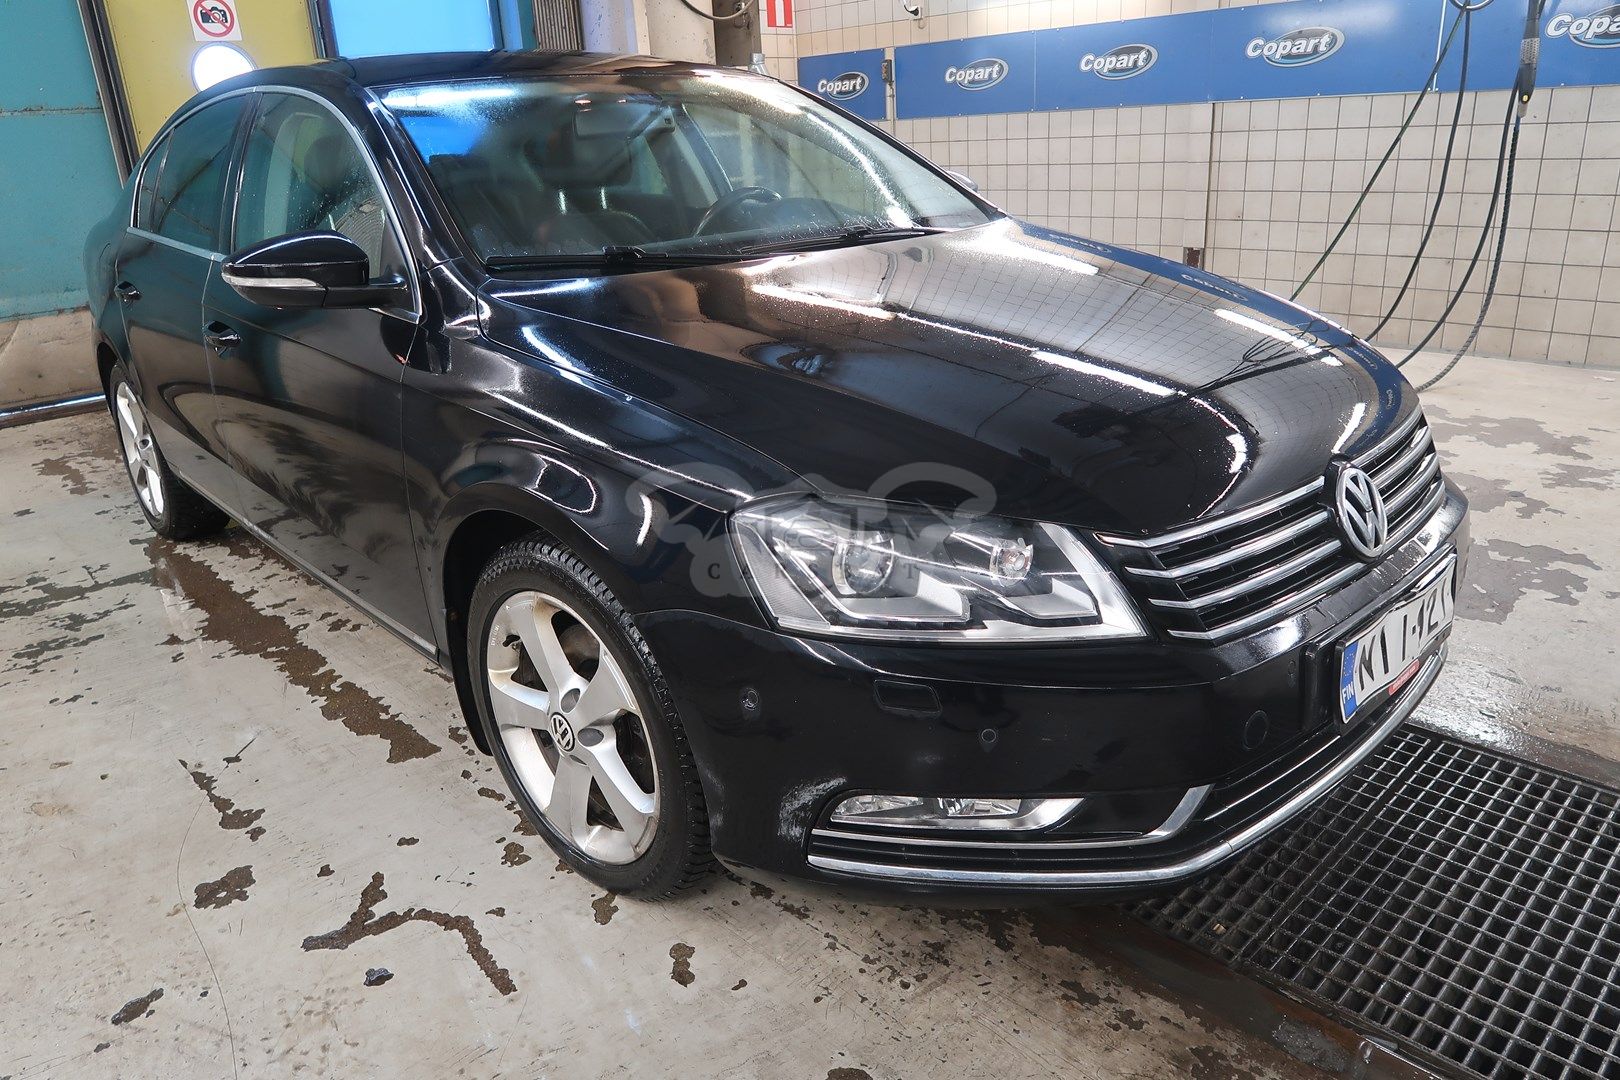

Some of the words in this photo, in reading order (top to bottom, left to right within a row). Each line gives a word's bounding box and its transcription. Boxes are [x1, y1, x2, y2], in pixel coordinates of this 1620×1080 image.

[1246, 32, 1331, 60] Copart
[1080, 47, 1147, 73] Copart
[945, 62, 1000, 84] Copart
[817, 75, 862, 95] Copart
[1341, 683, 1355, 705] FIN
